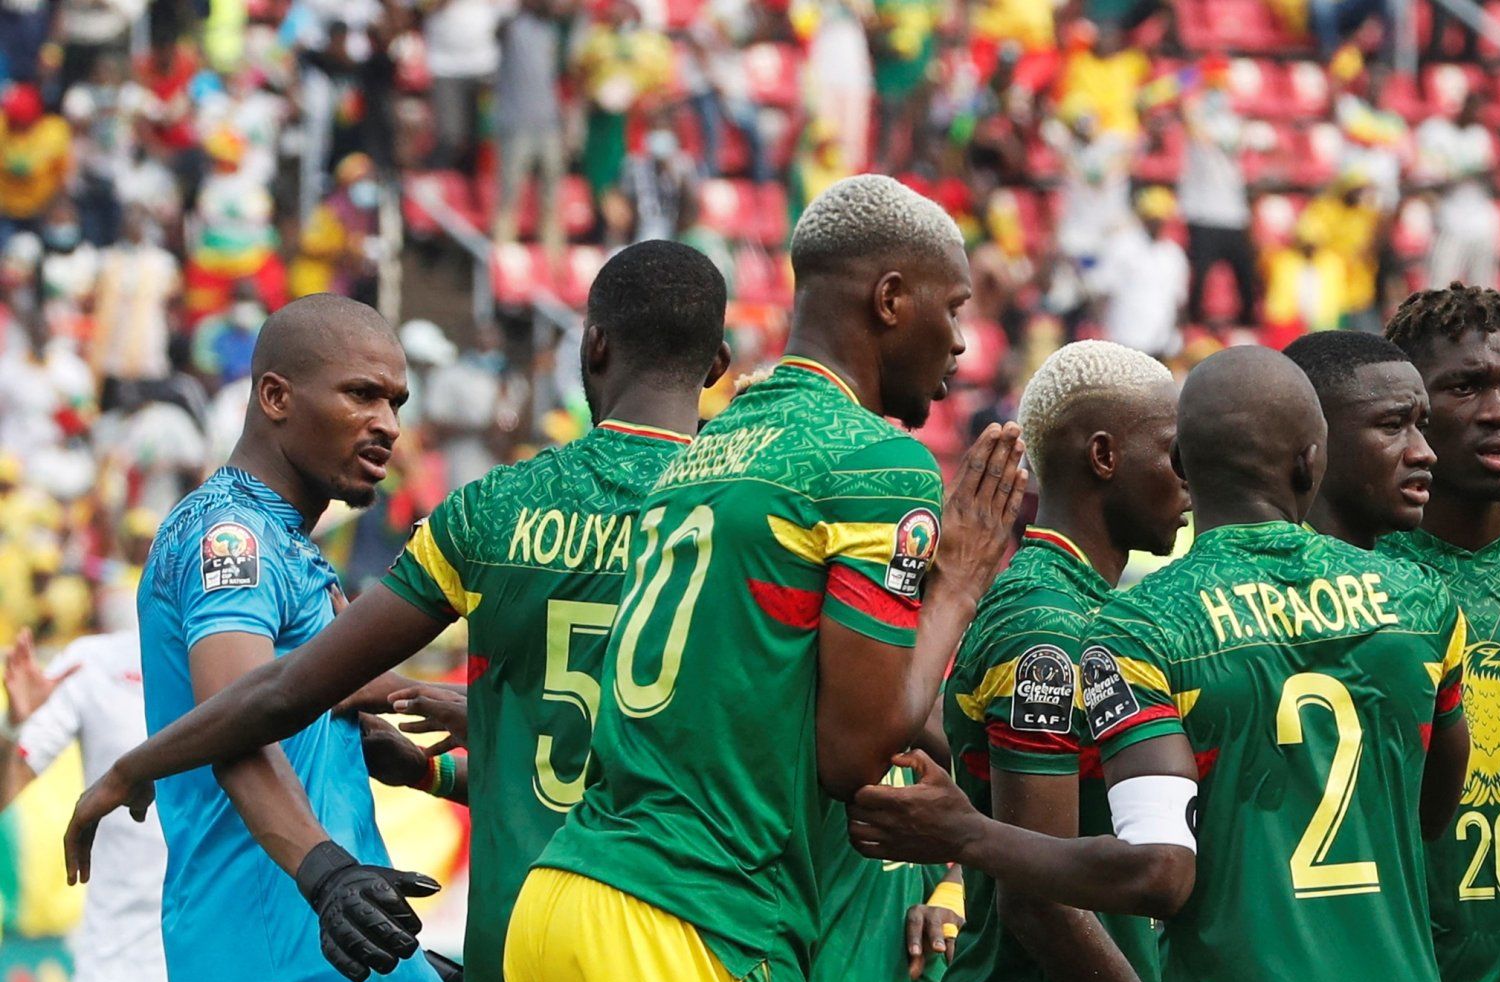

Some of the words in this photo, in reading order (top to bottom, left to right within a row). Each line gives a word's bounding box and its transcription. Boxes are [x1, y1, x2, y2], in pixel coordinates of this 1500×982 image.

[508, 506, 633, 571] KOUYA
[213, 556, 246, 568] CAF
[902, 558, 925, 570] CAF
[609, 505, 714, 719] 10
[1199, 573, 1399, 643] H.TRAORE
[532, 599, 619, 813] 5
[1017, 680, 1072, 699] Celebrate
[1024, 713, 1060, 725] CAF
[1095, 703, 1125, 728] CAF
[1276, 672, 1380, 899] 2
